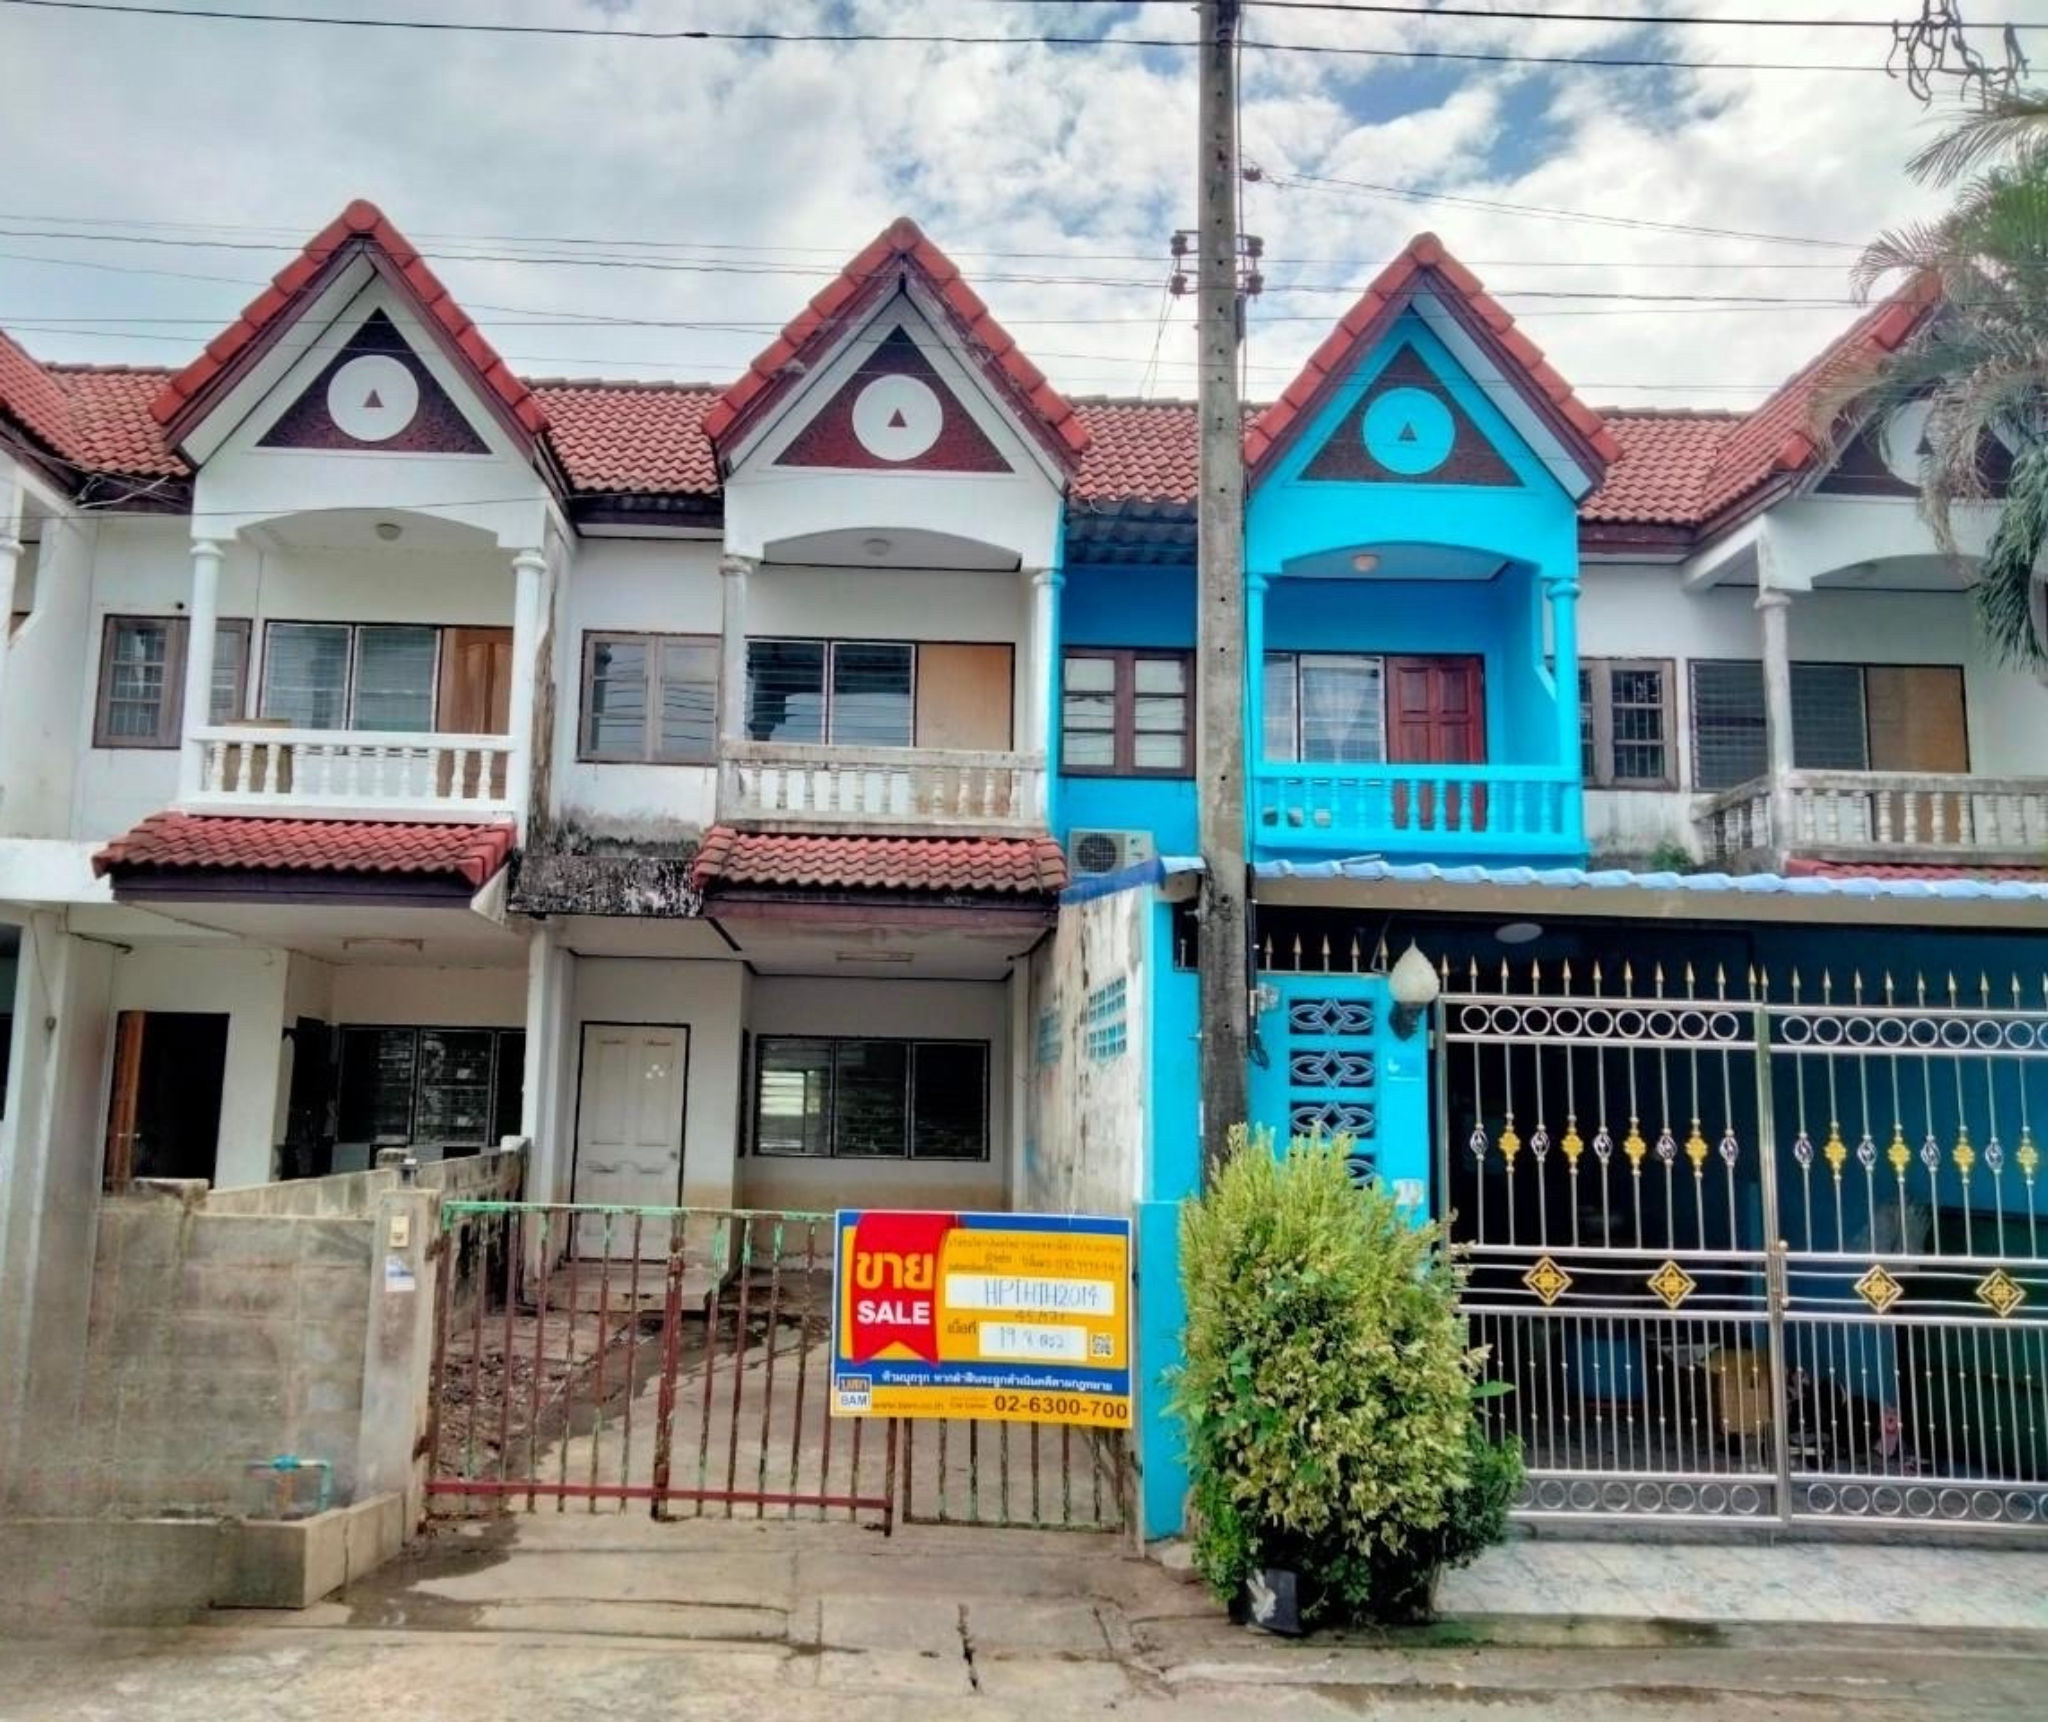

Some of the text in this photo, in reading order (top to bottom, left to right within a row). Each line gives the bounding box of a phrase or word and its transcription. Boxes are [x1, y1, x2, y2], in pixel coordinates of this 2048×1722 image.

[856, 1252, 934, 1290] ขาย
[857, 1300, 931, 1325] SALE
[841, 1394, 867, 1406] BAM
[994, 1394, 1128, 1420] 02-6300-700
